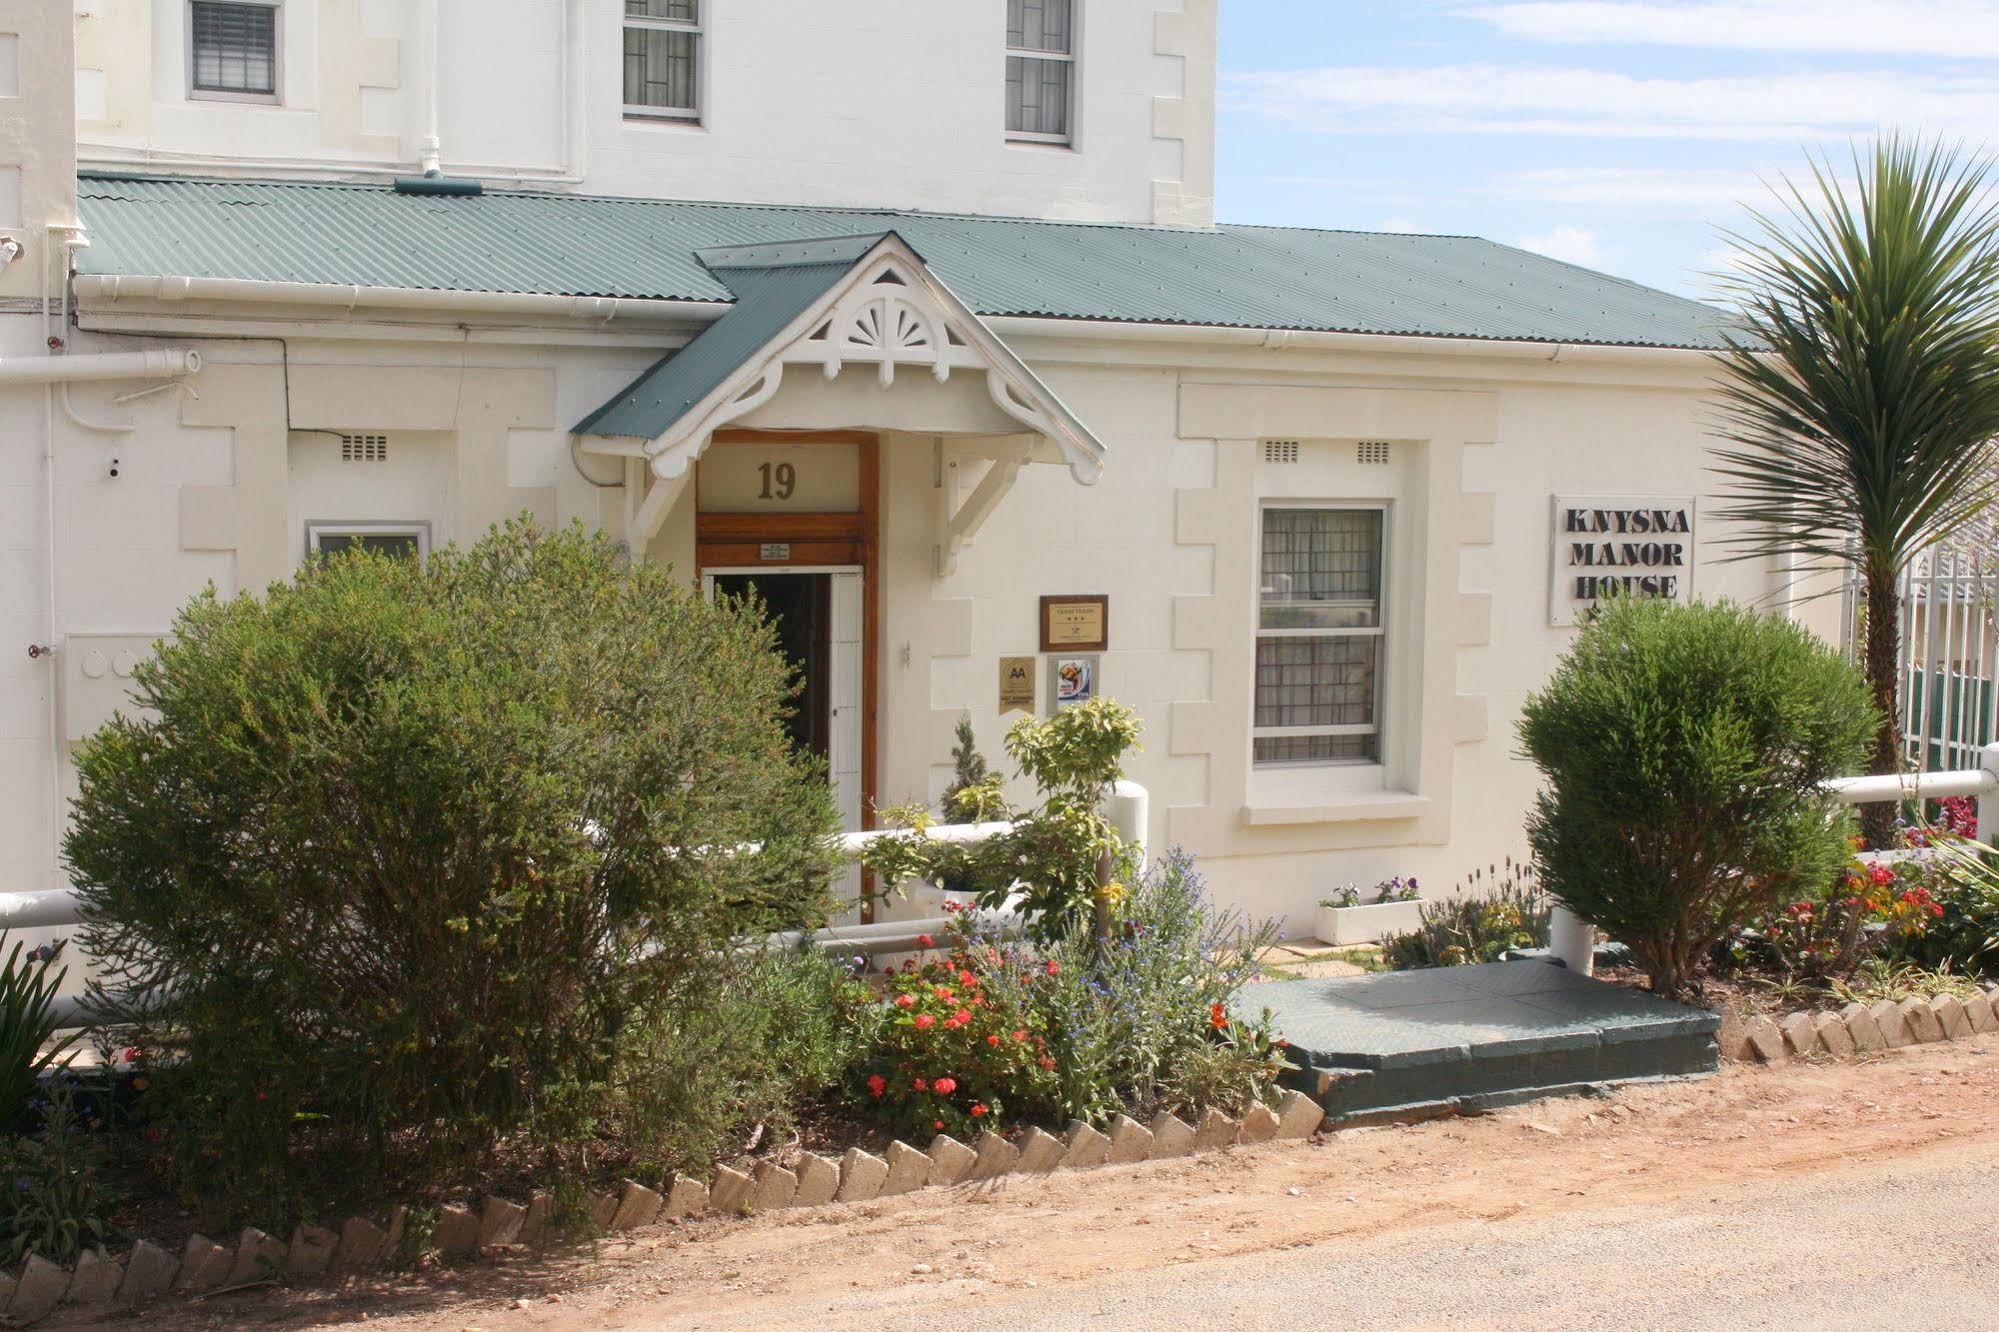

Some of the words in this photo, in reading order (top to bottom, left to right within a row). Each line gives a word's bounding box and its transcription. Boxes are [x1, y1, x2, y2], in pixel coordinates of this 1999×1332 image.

[758, 462, 796, 499] 19
[1566, 509, 1690, 533] KNYSNA
[1569, 542, 1683, 566] MANOR
[1575, 575, 1677, 599] HOUSE
[1010, 667, 1025, 679] AA
